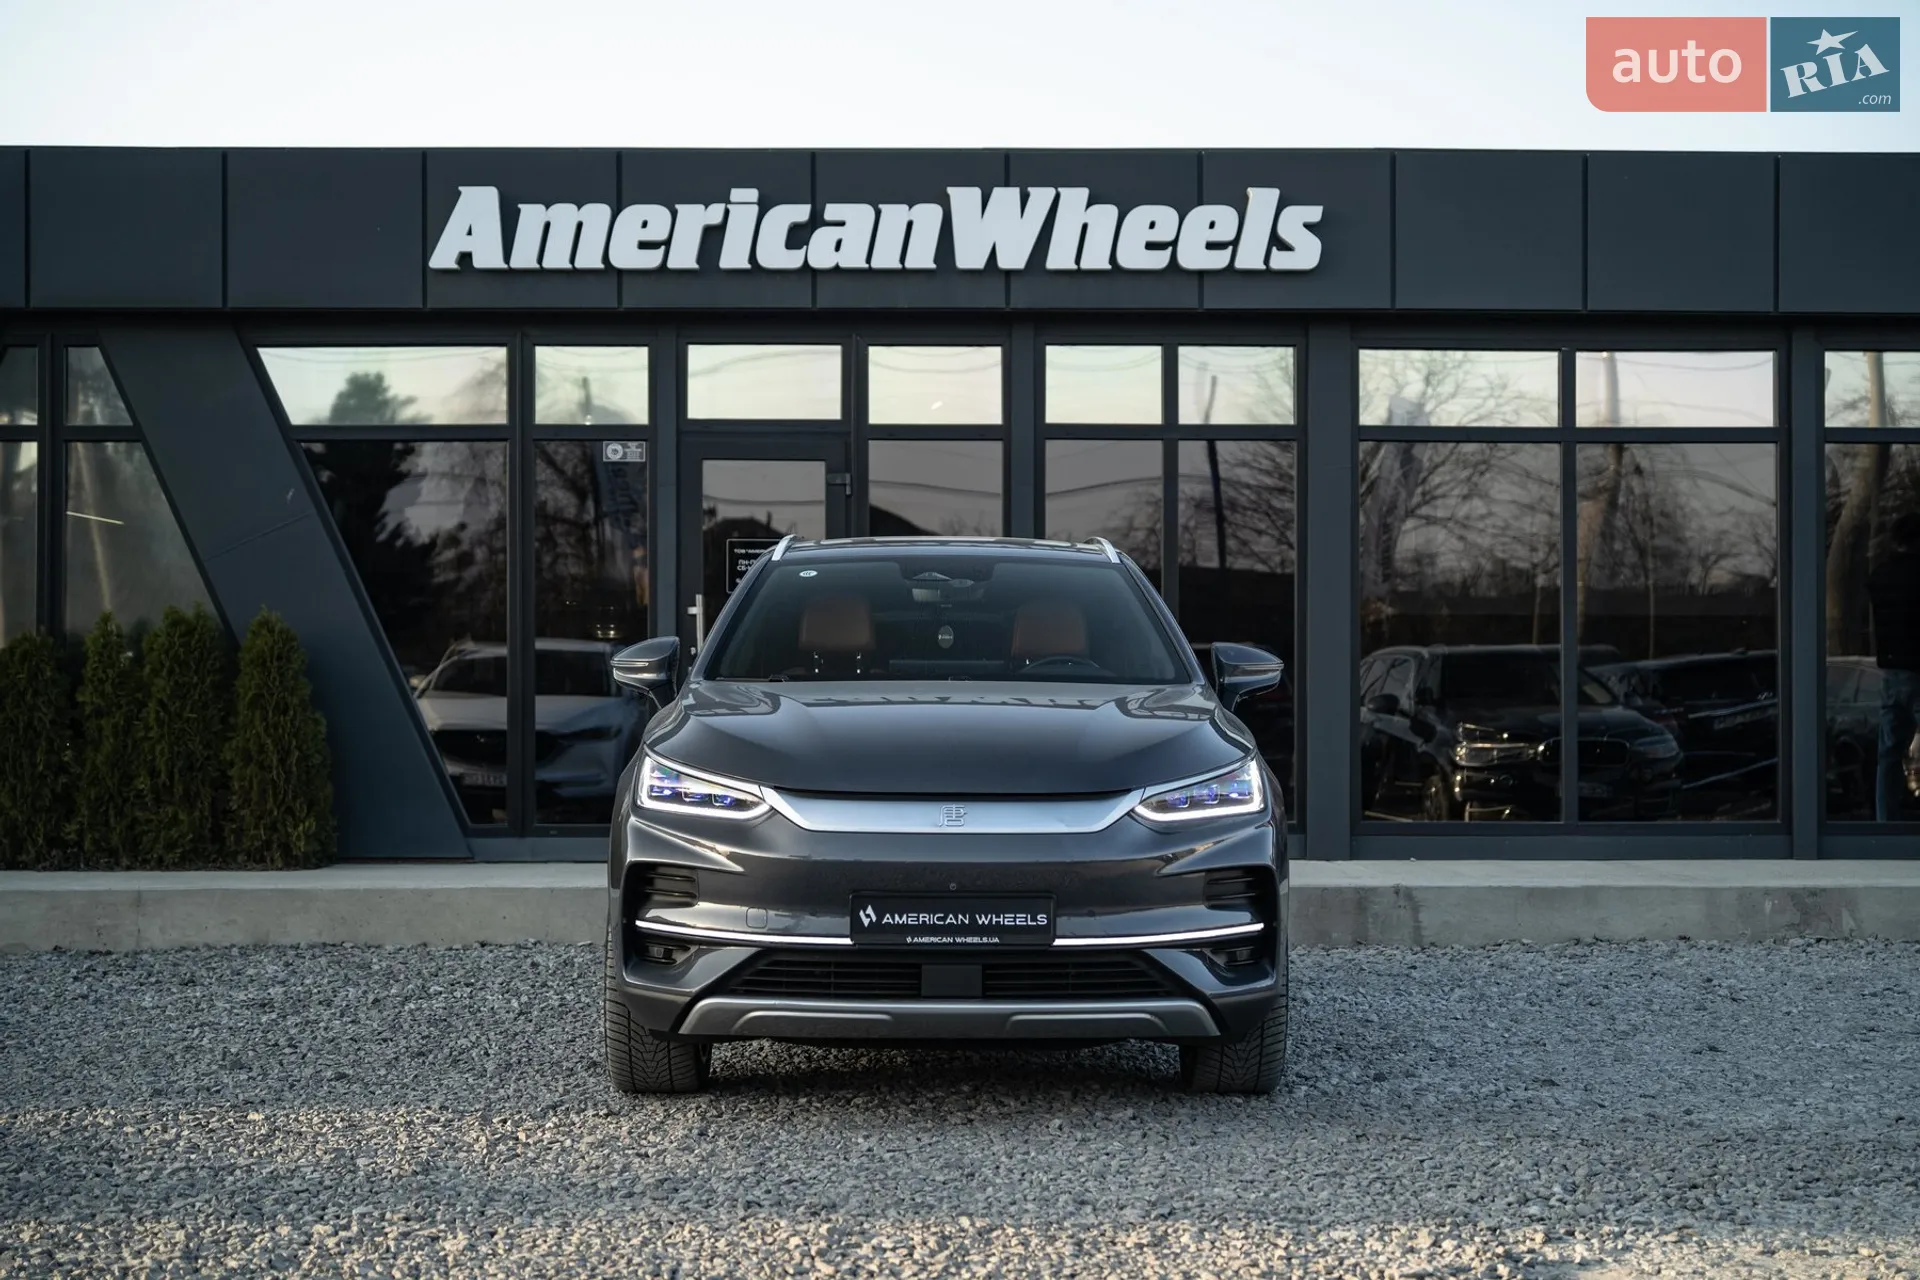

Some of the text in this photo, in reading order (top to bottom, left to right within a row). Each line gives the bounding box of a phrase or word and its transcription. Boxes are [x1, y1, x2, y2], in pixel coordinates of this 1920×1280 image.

[429, 186, 1323, 271] AmericanWheels
[938, 804, 967, 827] 唐
[882, 913, 1048, 925] AMERICAN WHEELS
